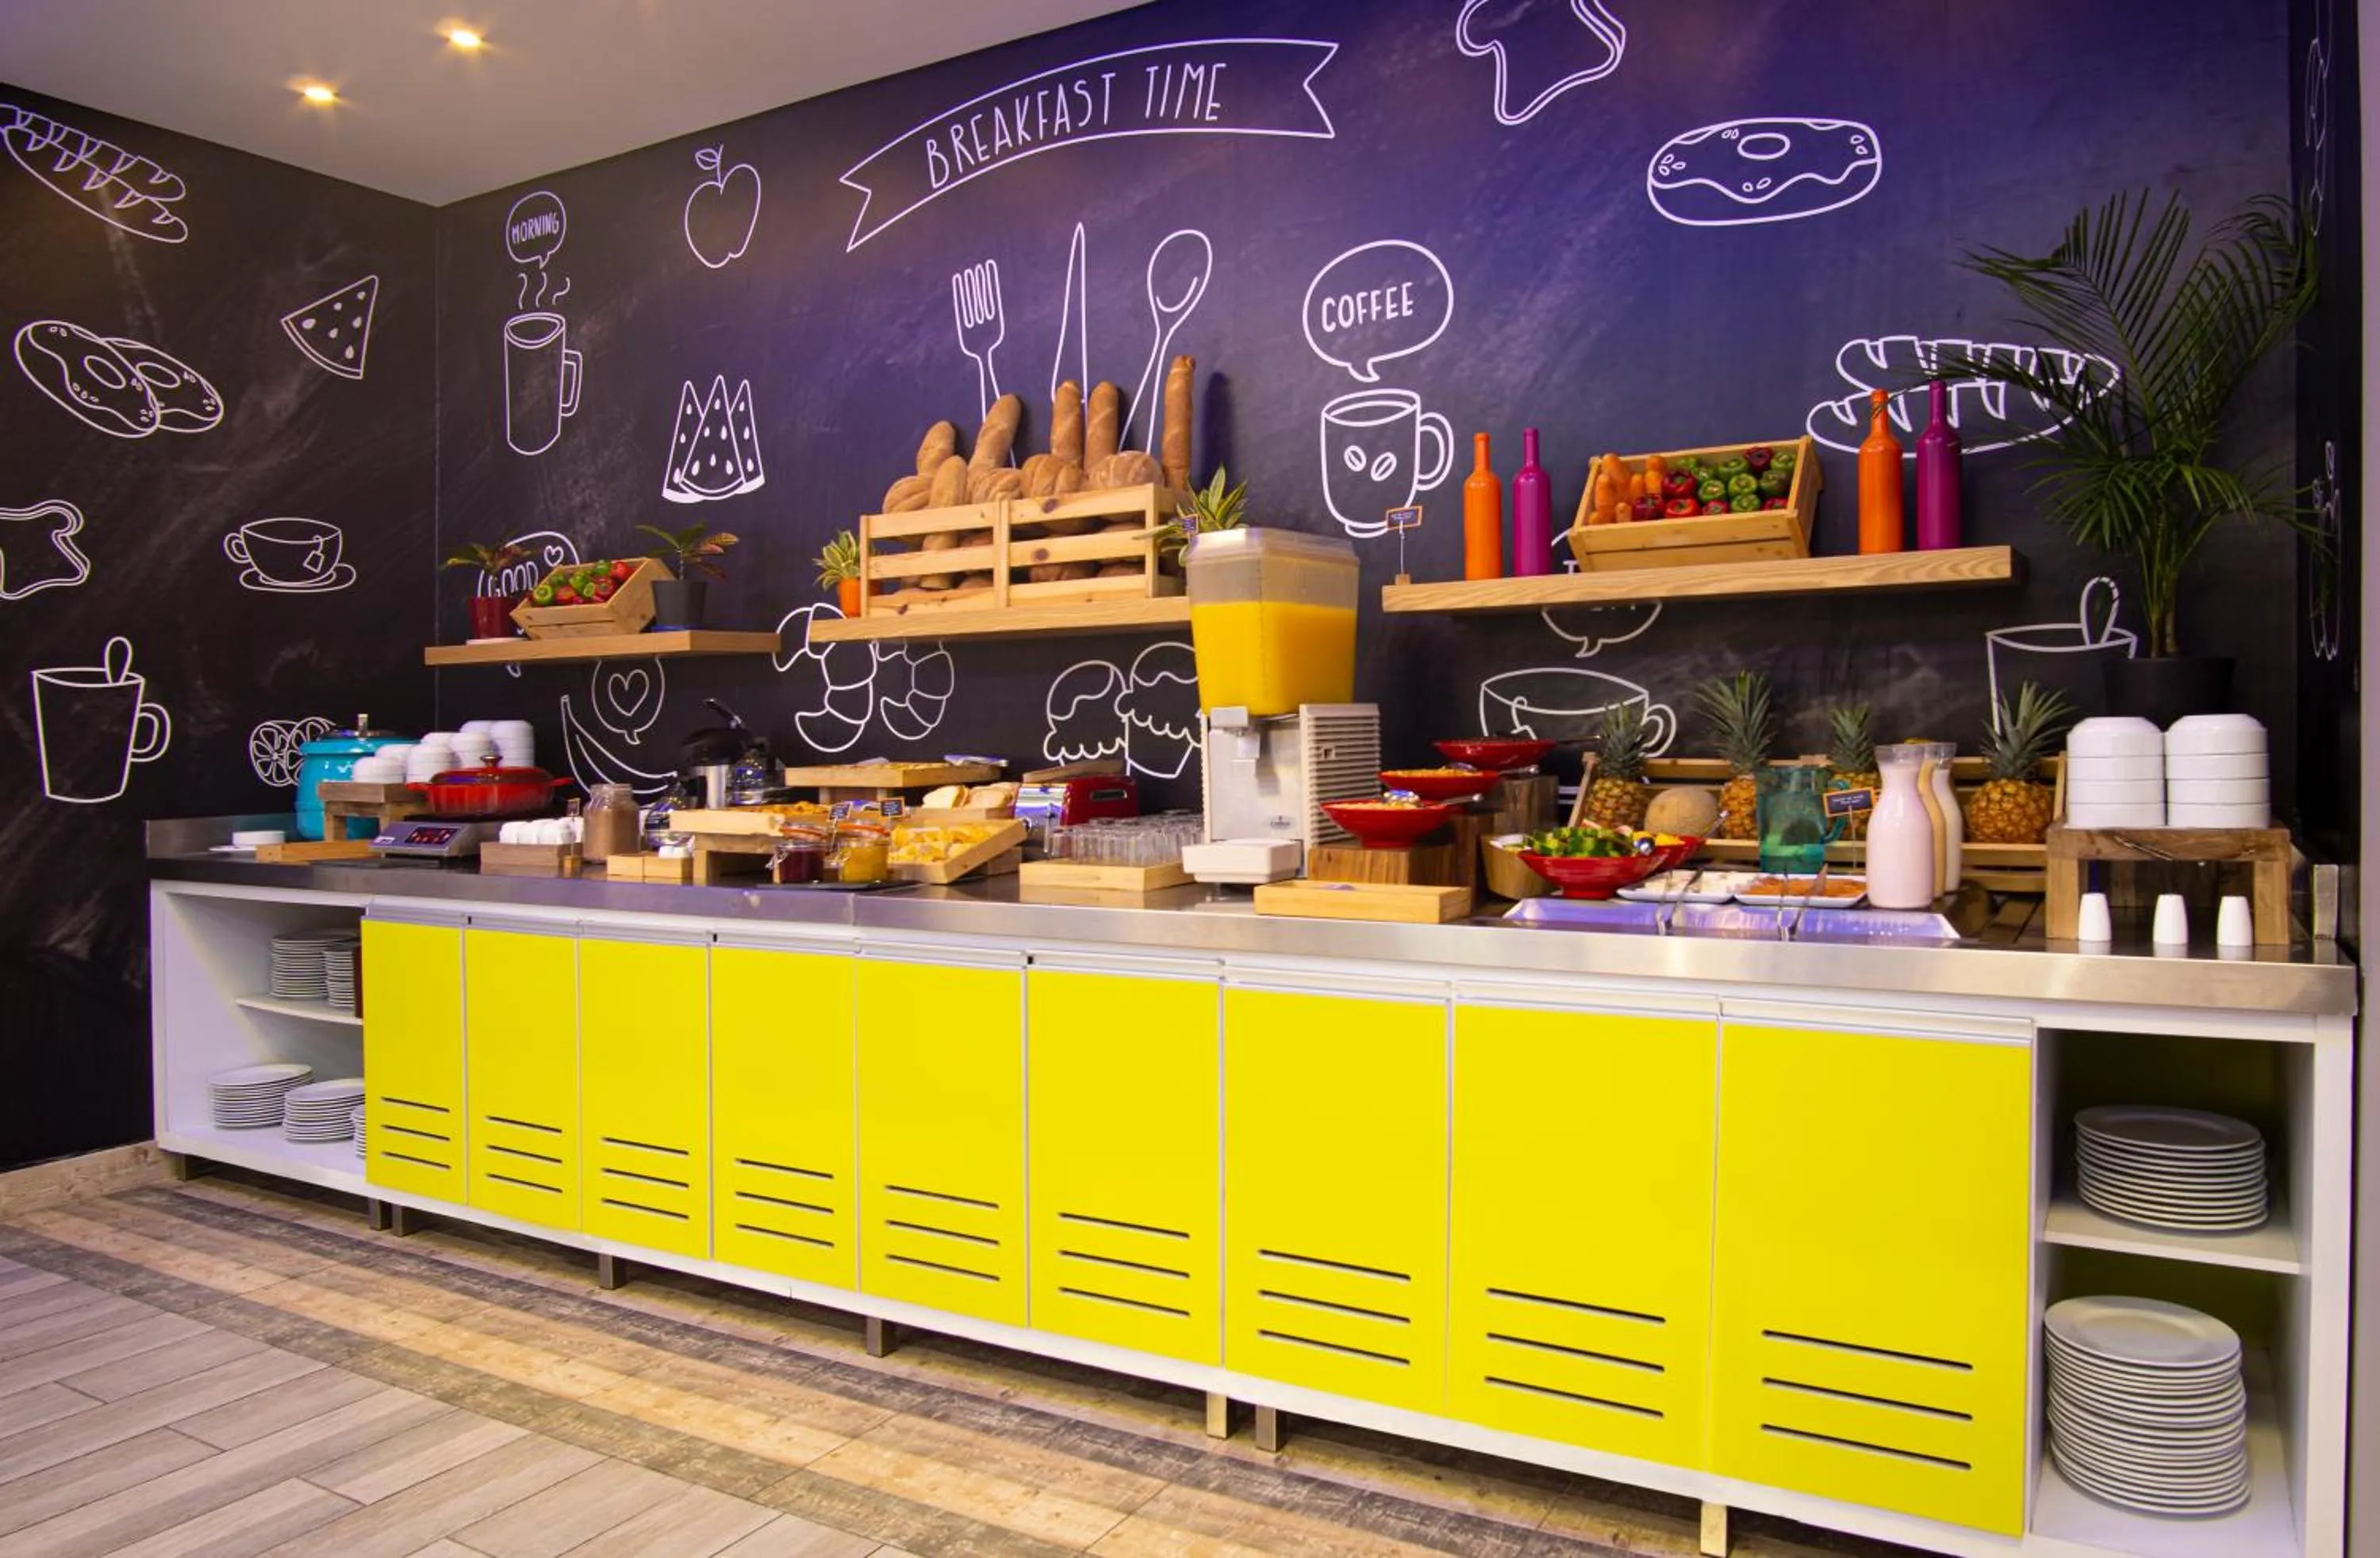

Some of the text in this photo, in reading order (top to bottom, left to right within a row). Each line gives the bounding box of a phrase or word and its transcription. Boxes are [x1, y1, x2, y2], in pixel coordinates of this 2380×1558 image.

[926, 63, 1226, 189] BREAKFAST TIME
[512, 212, 559, 244] MORNING
[1321, 281, 1414, 332] COFFEE
